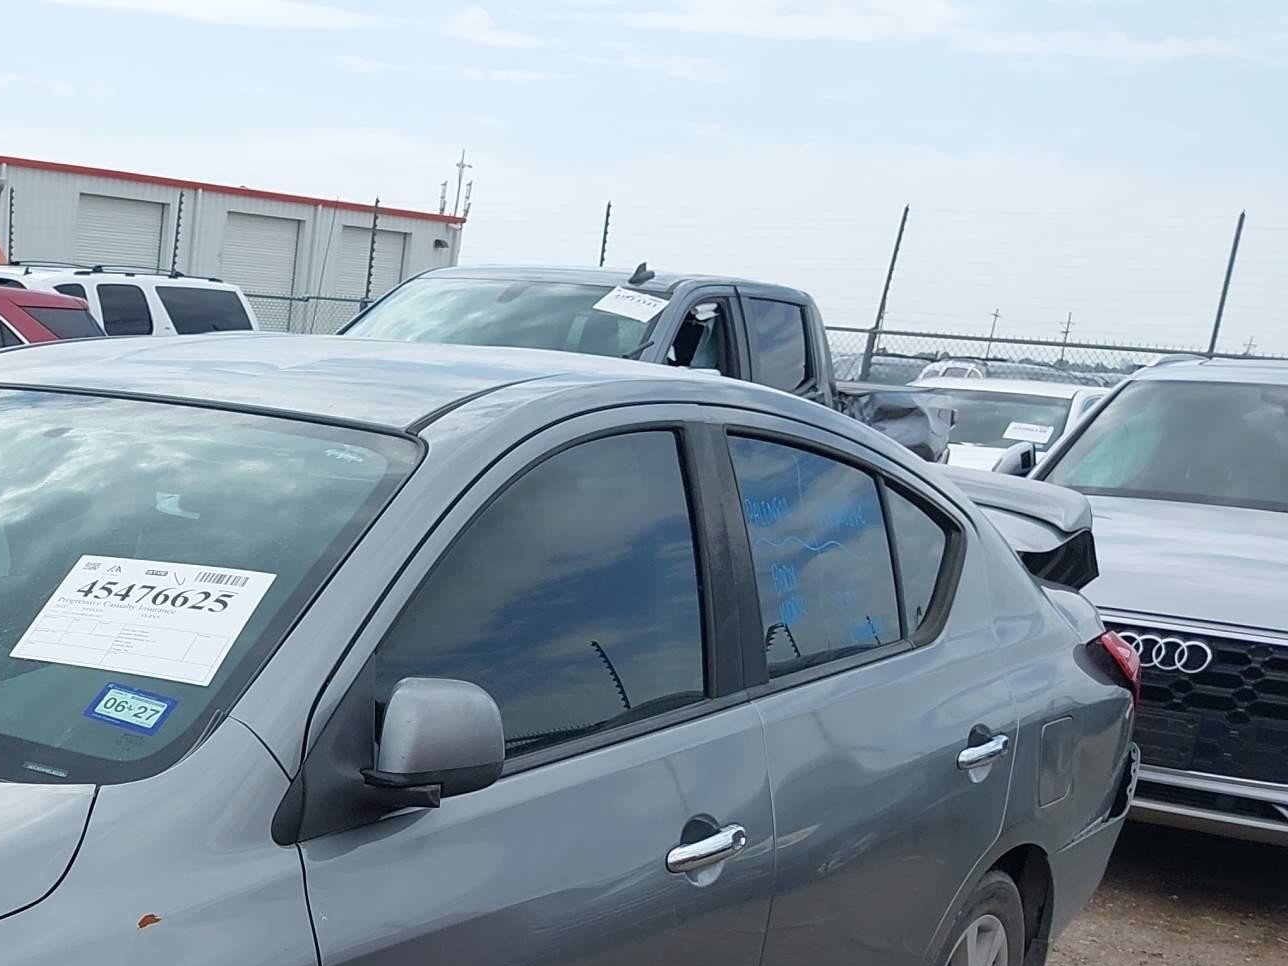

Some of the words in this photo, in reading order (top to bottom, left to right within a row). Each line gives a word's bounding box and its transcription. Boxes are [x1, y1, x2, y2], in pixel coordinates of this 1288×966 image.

[56, 596, 103, 607] Progressive
[138, 604, 177, 616] Insurance
[76, 579, 240, 613] 45476625
[103, 697, 129, 713] 06
[132, 705, 161, 721] 27
